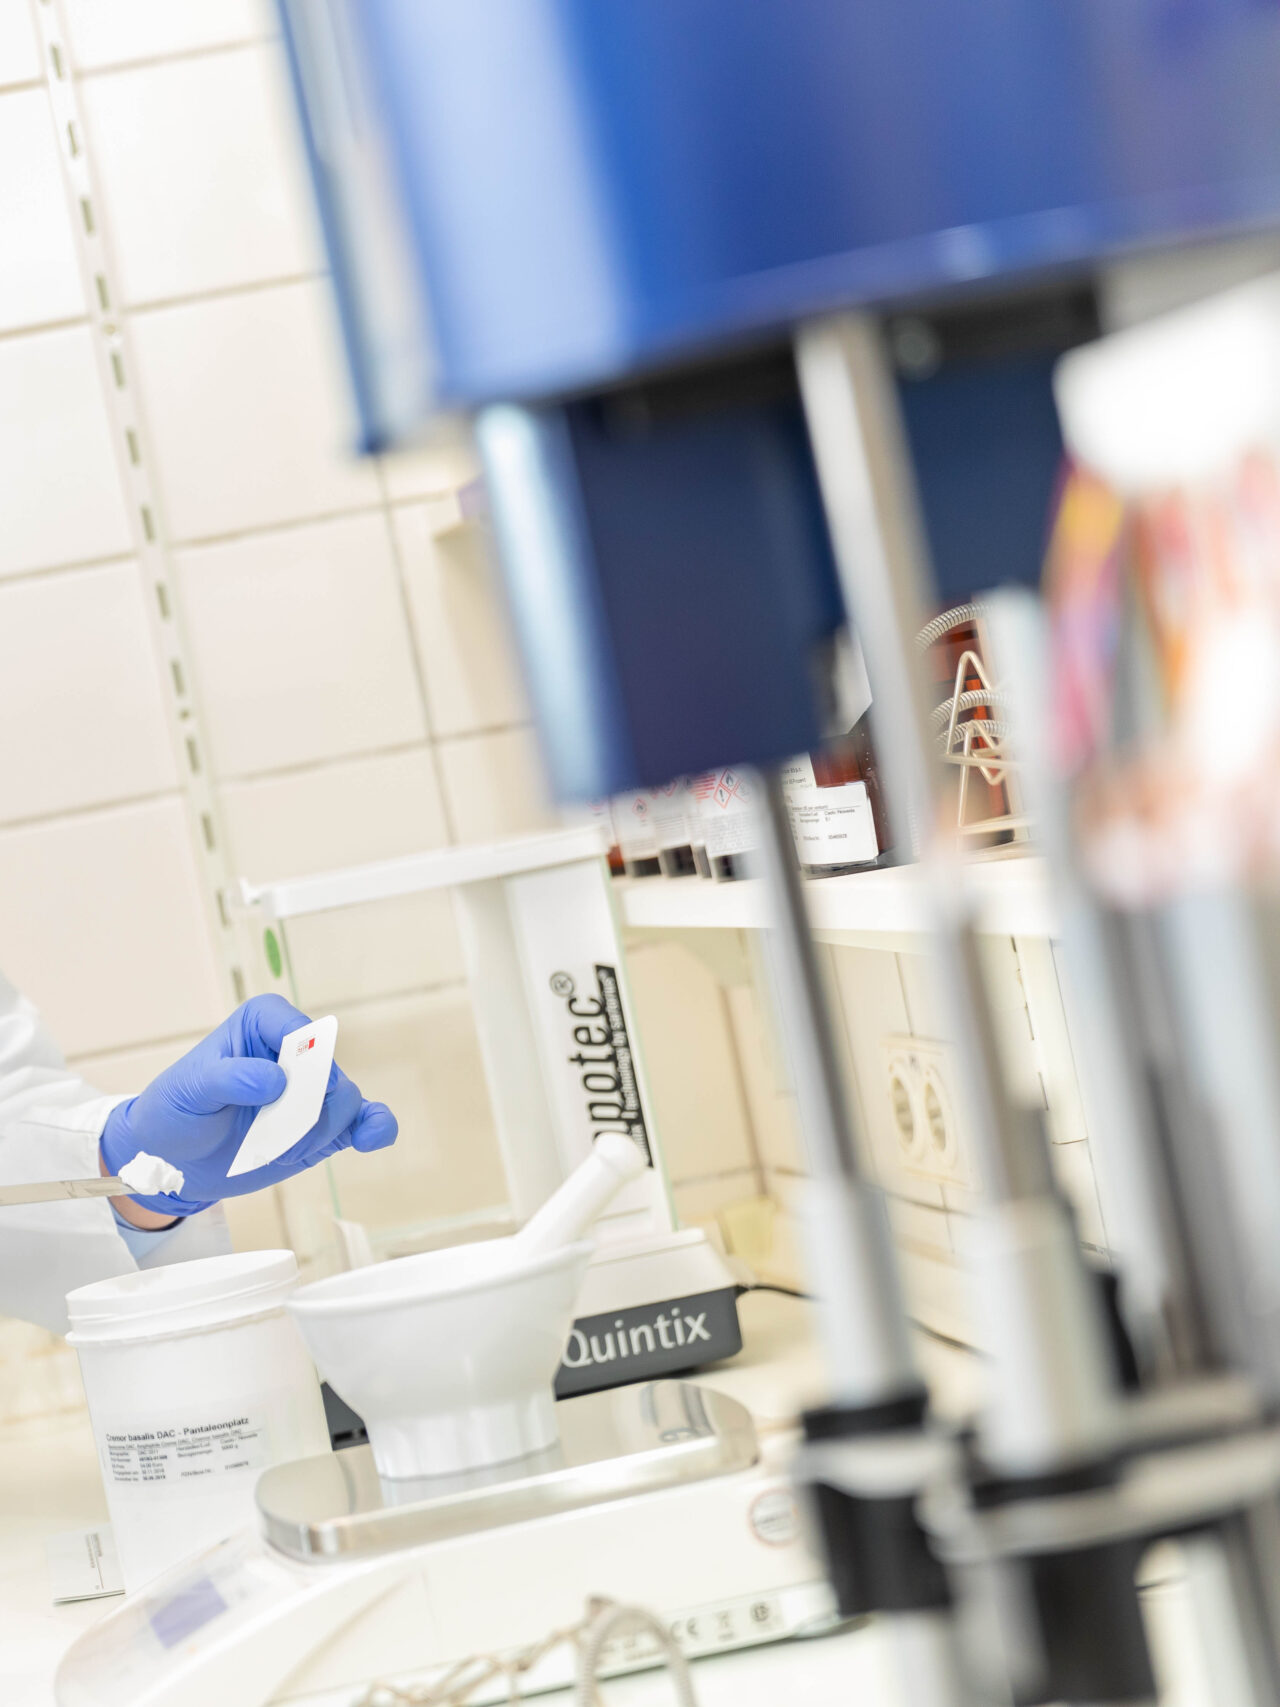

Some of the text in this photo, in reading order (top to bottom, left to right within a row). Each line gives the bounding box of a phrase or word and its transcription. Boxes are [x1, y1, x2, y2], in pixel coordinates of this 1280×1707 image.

[562, 1307, 712, 1368] Quintix
[128, 1433, 155, 1442] basalis
[156, 1429, 175, 1439] DAC
[183, 1417, 249, 1436] Pantaleonplatz
